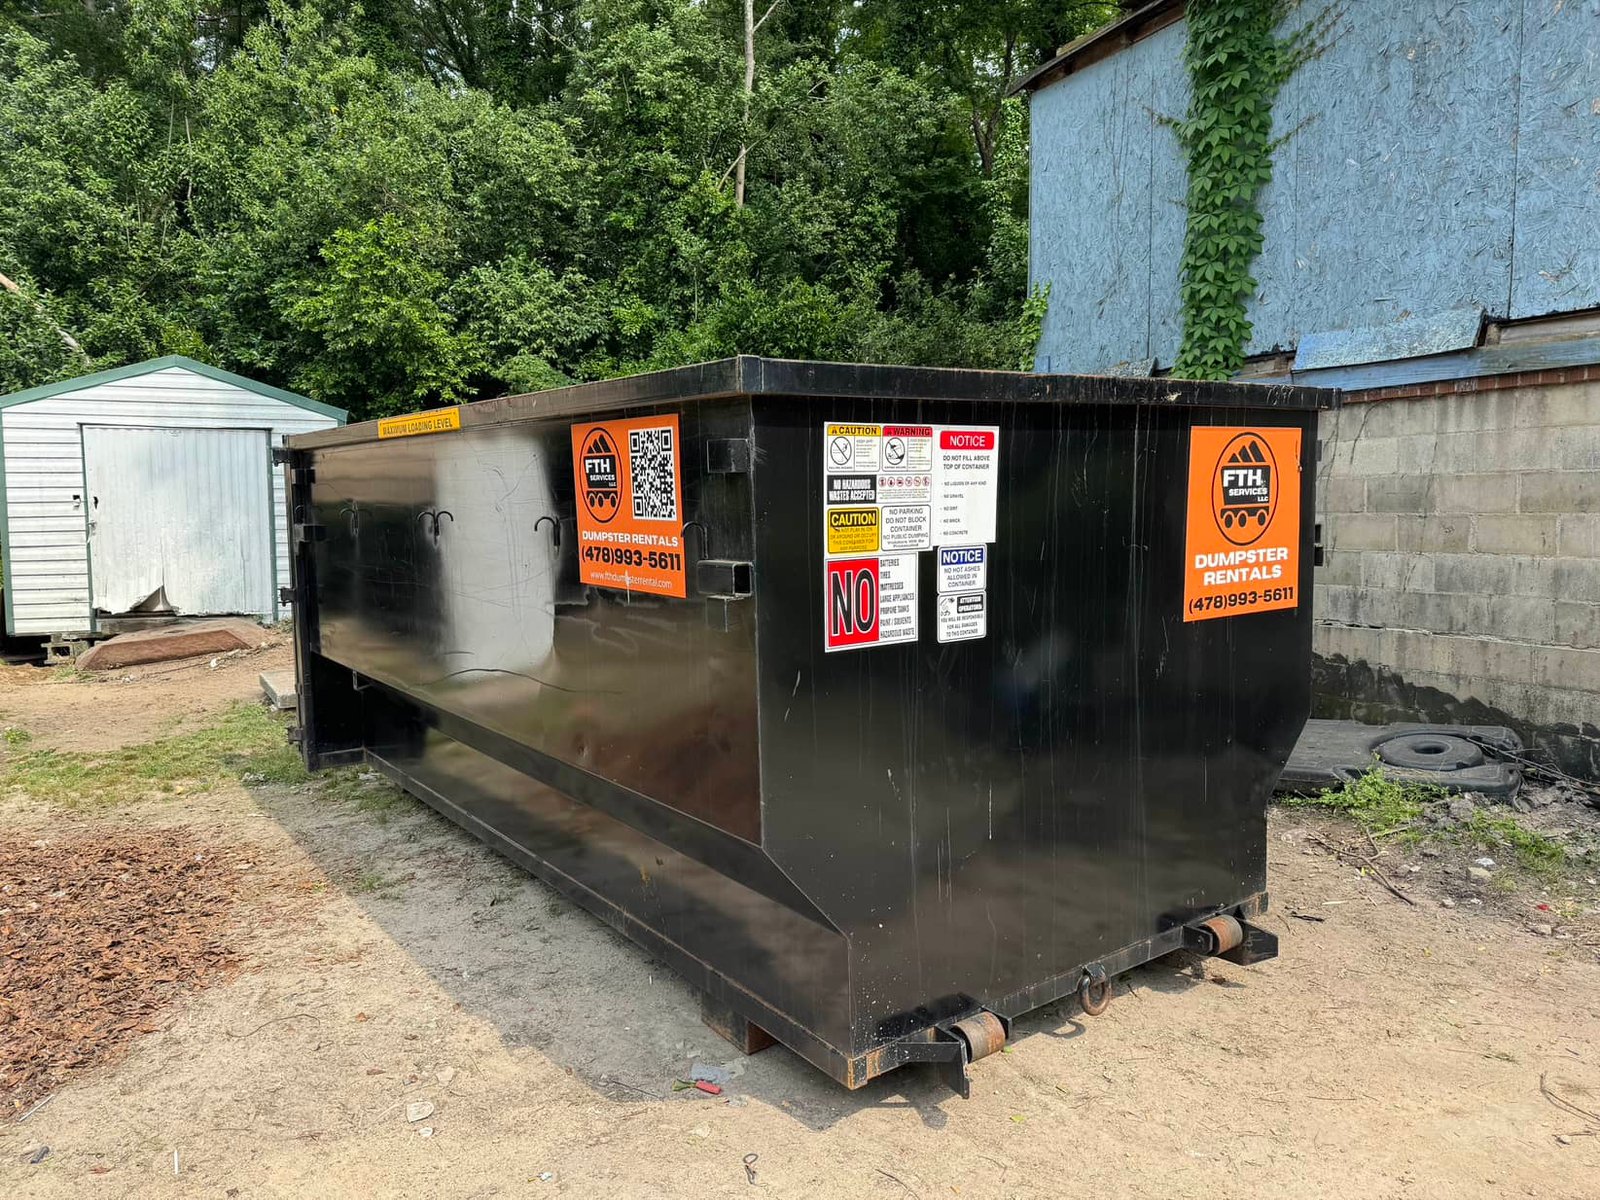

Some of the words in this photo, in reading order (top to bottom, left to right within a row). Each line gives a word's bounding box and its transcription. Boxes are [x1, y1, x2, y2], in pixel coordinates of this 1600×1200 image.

[408, 421, 432, 432] LOADING
[434, 418, 452, 428] LEVEL
[894, 427, 930, 436] WARNING
[950, 435, 986, 447] NOTICE
[585, 459, 610, 474] FTH
[1223, 469, 1262, 487] FTH
[1229, 488, 1268, 496] SERVICES
[831, 513, 875, 526] CAUTION
[582, 531, 631, 544] DUMPSTER
[633, 535, 678, 547] RENTALS
[582, 545, 681, 571] (478)993-5611
[880, 558, 899, 567] BATTERIES
[943, 550, 982, 563] NOTICE
[1194, 547, 1288, 568] DUMPSTER
[1203, 564, 1282, 586] RENTALS
[830, 568, 876, 636] NO
[1189, 586, 1294, 614] (478)993-5611
